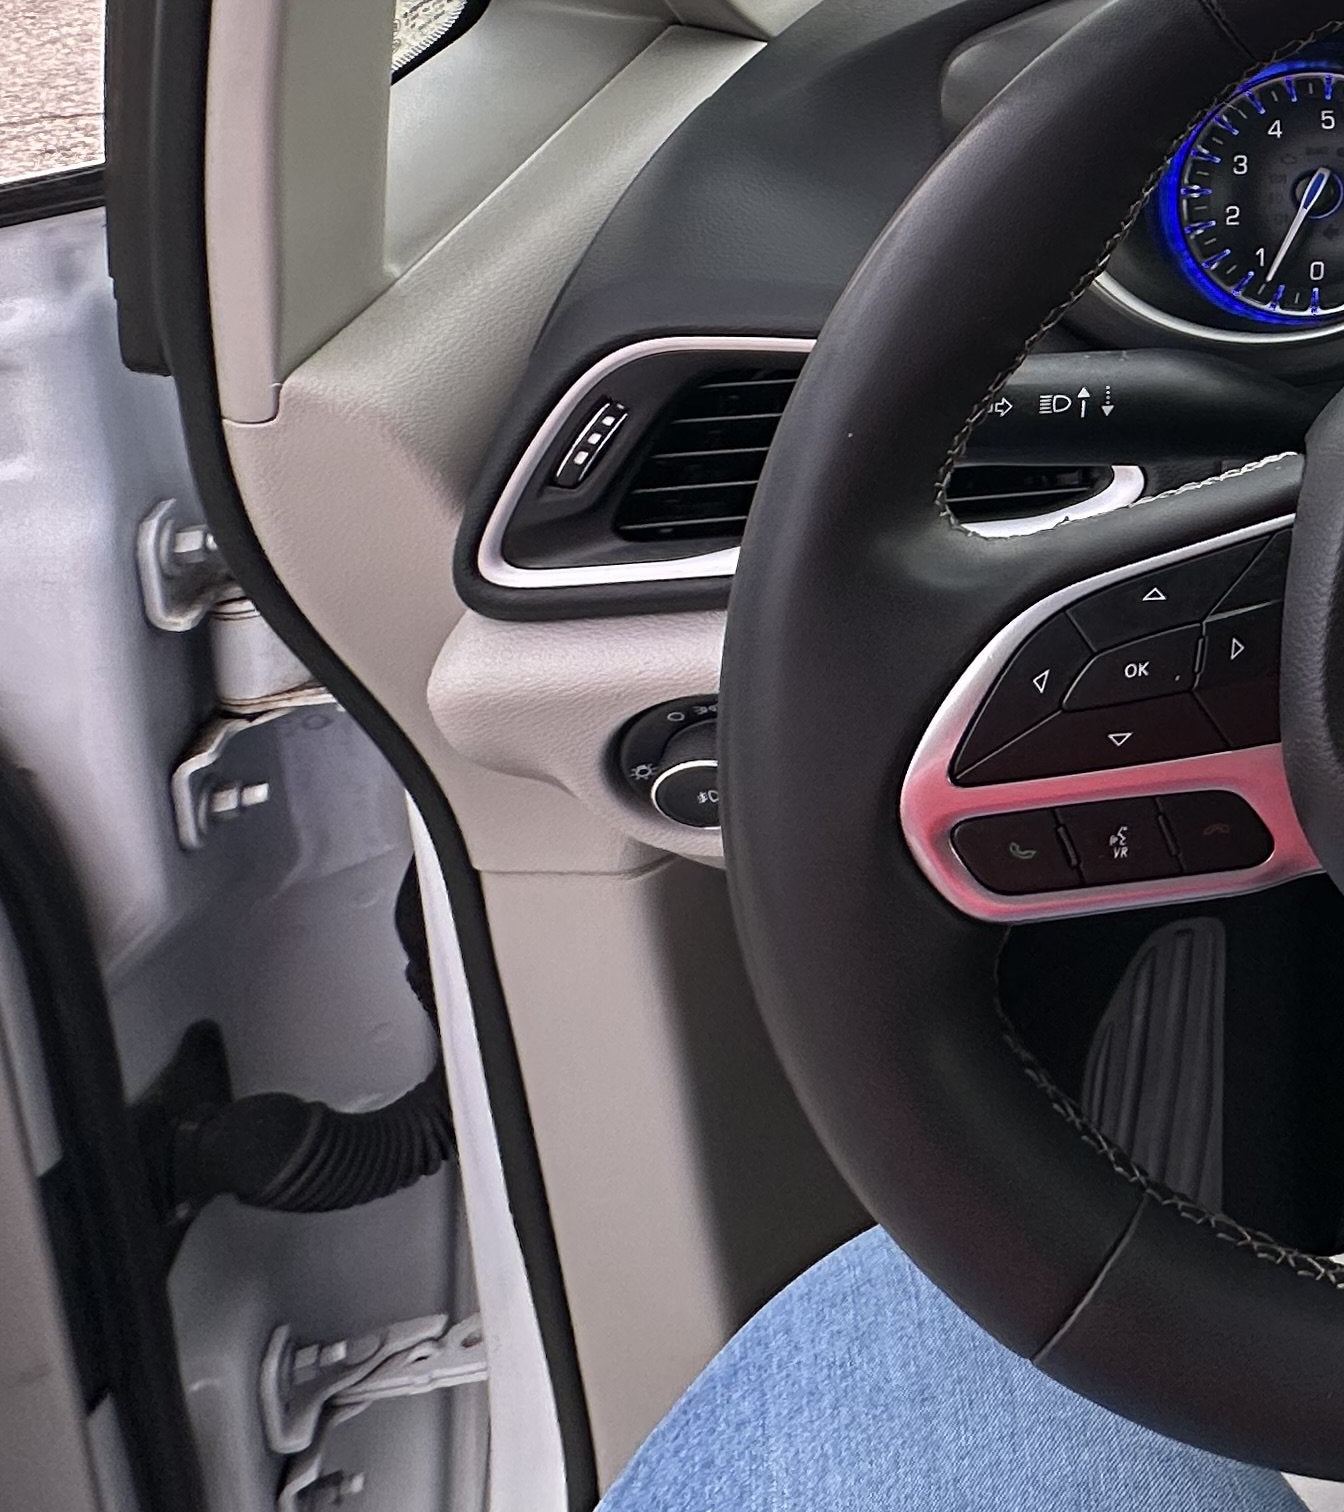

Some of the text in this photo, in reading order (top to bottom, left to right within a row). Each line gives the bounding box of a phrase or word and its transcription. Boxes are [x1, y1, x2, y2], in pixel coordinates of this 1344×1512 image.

[1267, 119, 1283, 140] 4
[1320, 109, 1336, 130] 5
[1232, 154, 1248, 175] 3
[1225, 205, 1240, 226] 2
[1255, 247, 1265, 267] 1
[1309, 261, 1325, 281] 0
[1124, 662, 1149, 677] OK
[1113, 846, 1129, 859] VR
